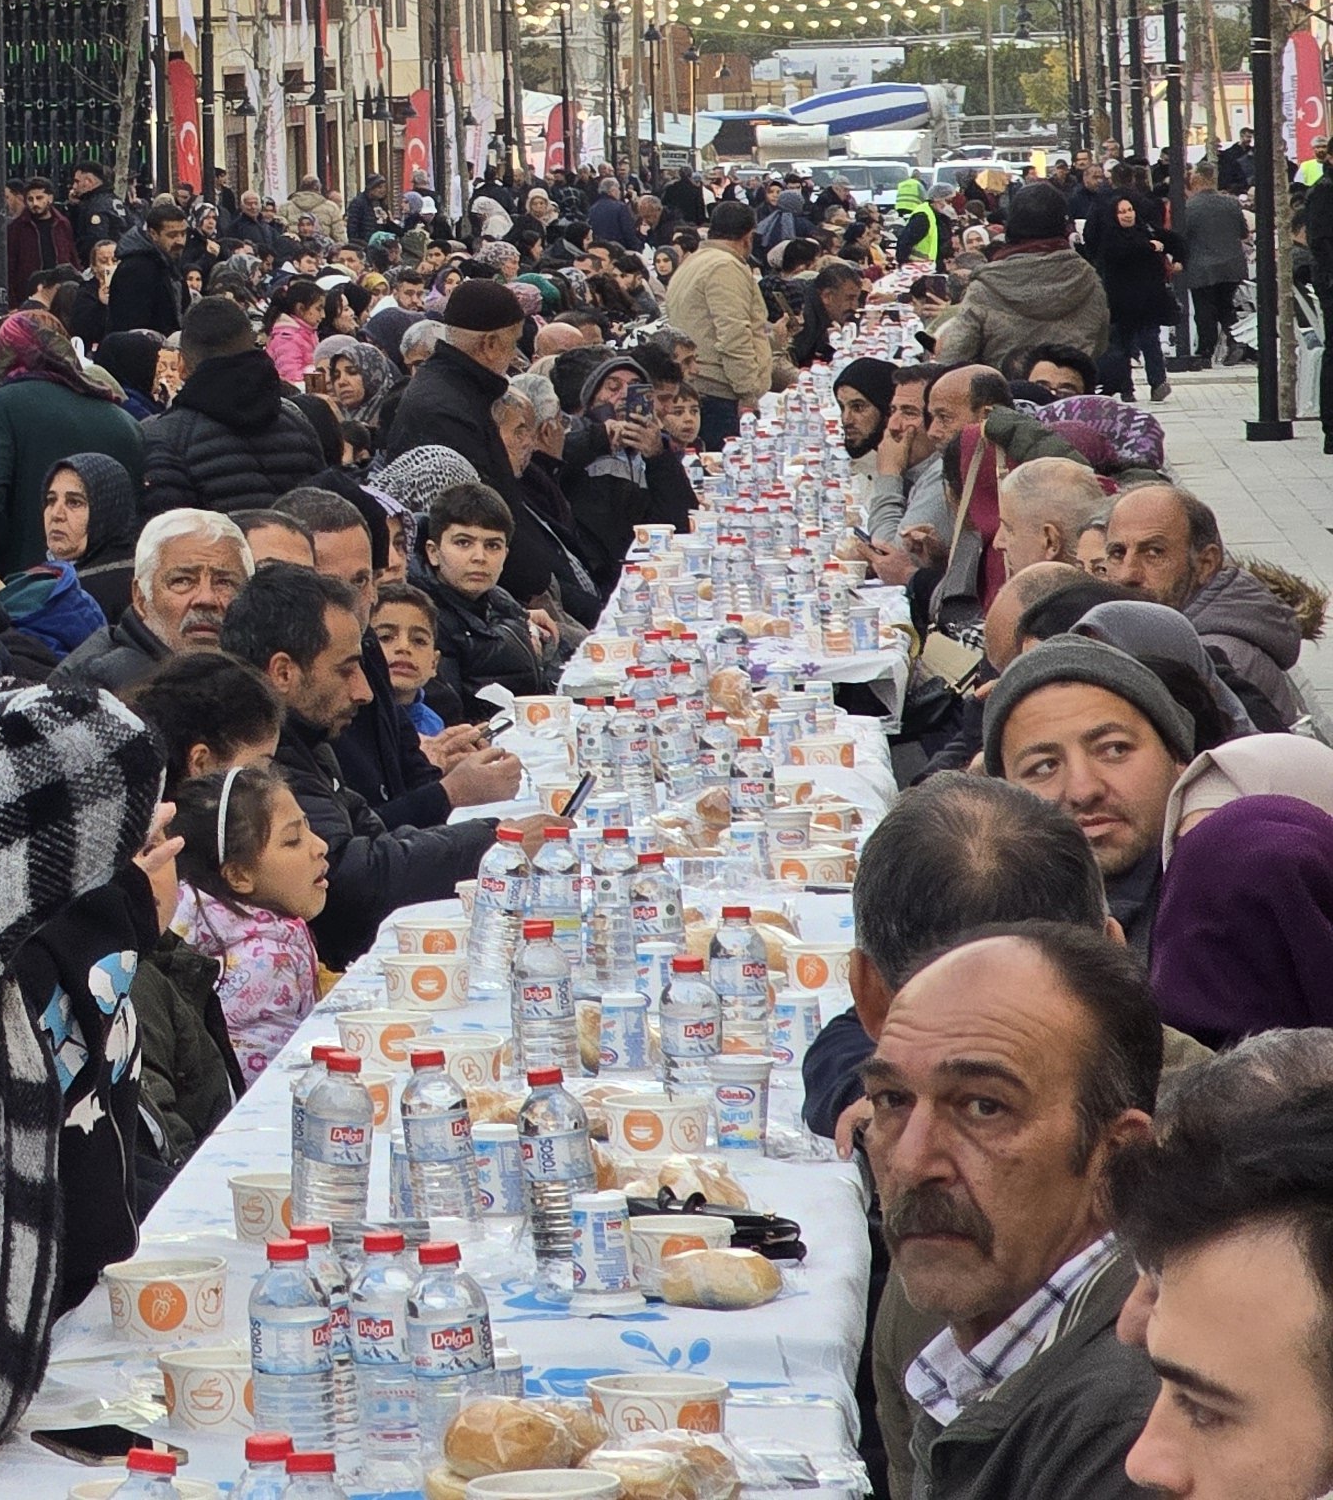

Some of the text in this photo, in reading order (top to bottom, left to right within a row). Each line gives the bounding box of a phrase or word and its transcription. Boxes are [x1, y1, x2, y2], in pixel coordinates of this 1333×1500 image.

[331, 1128, 364, 1144] Dalga
[538, 1138, 557, 1174] TOROS
[358, 1320, 391, 1339] Dalga
[434, 1330, 472, 1349] Dalga
